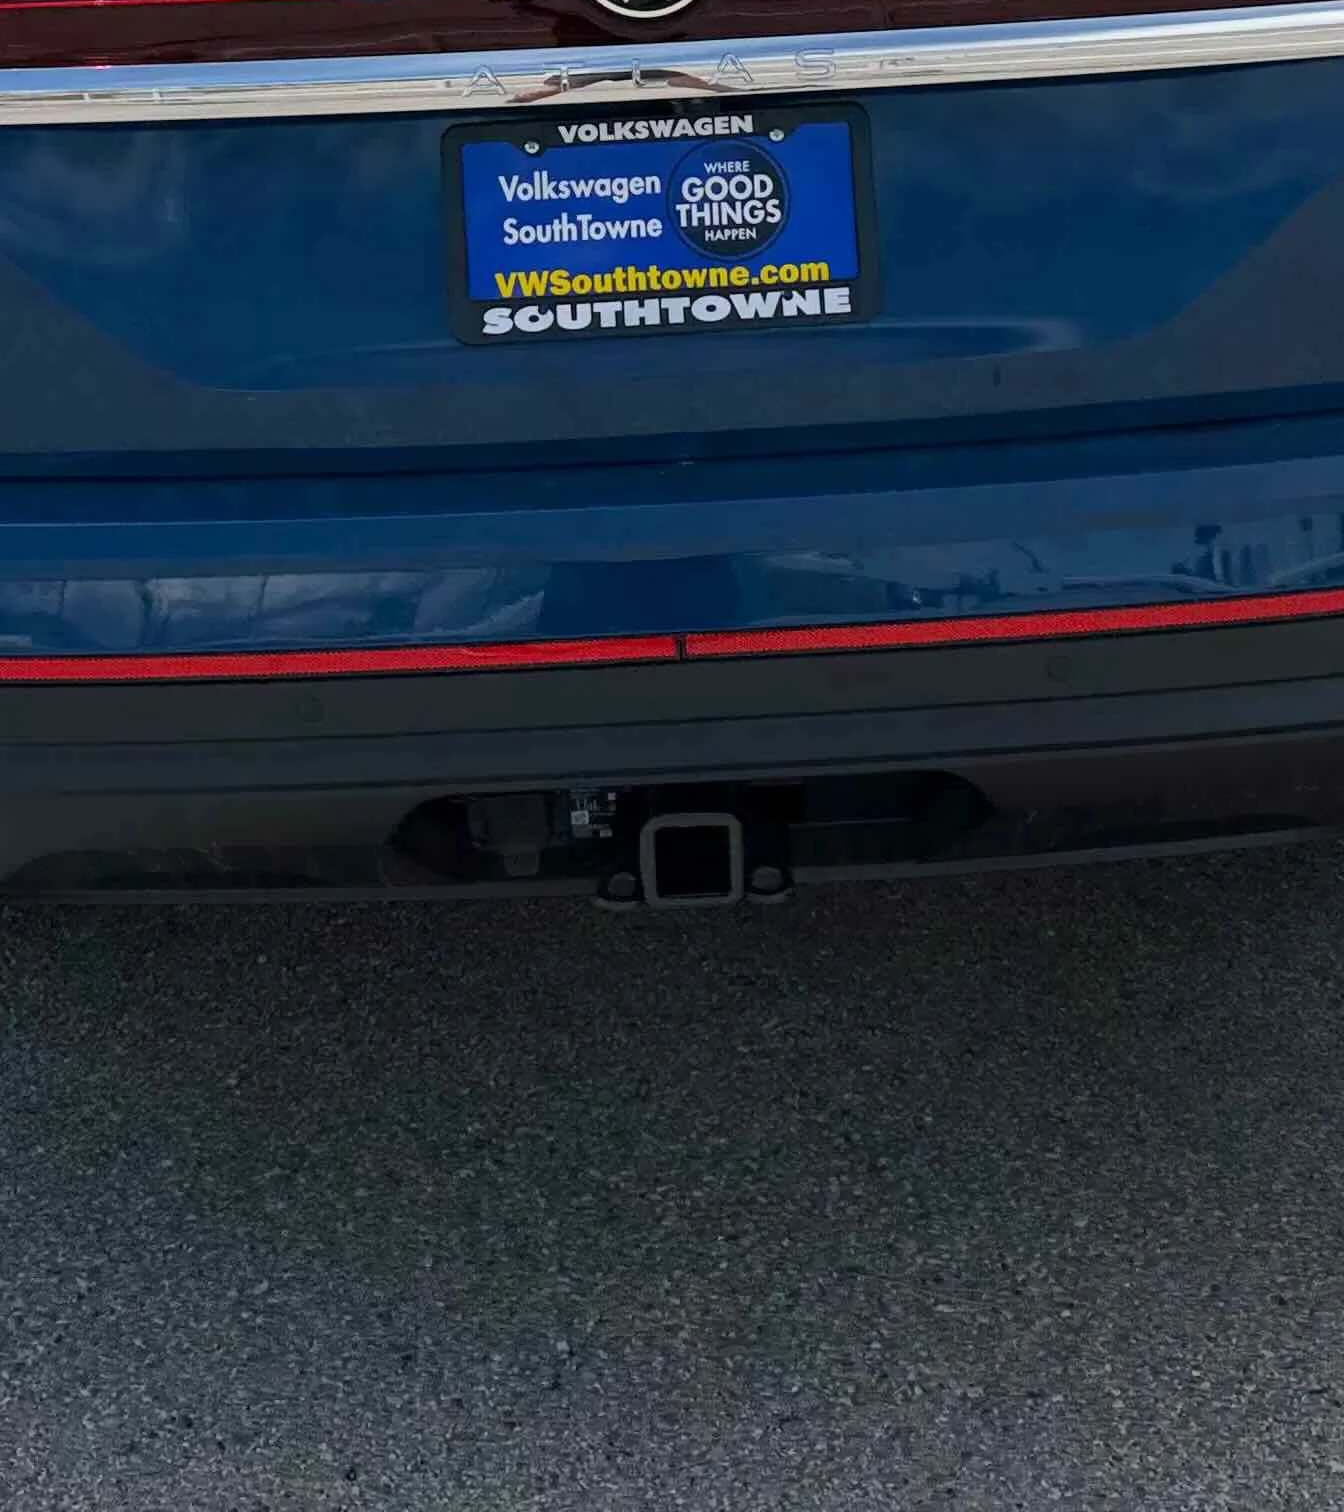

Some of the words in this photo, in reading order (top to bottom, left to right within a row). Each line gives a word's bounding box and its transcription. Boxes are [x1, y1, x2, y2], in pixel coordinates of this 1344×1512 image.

[462, 47, 837, 99] ATLAS
[558, 114, 754, 144] VOLKSWAGEN
[704, 159, 751, 175] WHERE
[498, 171, 662, 205] Volkswagen
[681, 174, 774, 203] GOOD
[503, 212, 663, 246] SouthTowne
[676, 198, 782, 228] THINGS
[704, 227, 757, 243] HAPPEN
[495, 261, 831, 299] VWSouthtowne.com
[482, 287, 852, 335] SOUTHTOWNE
